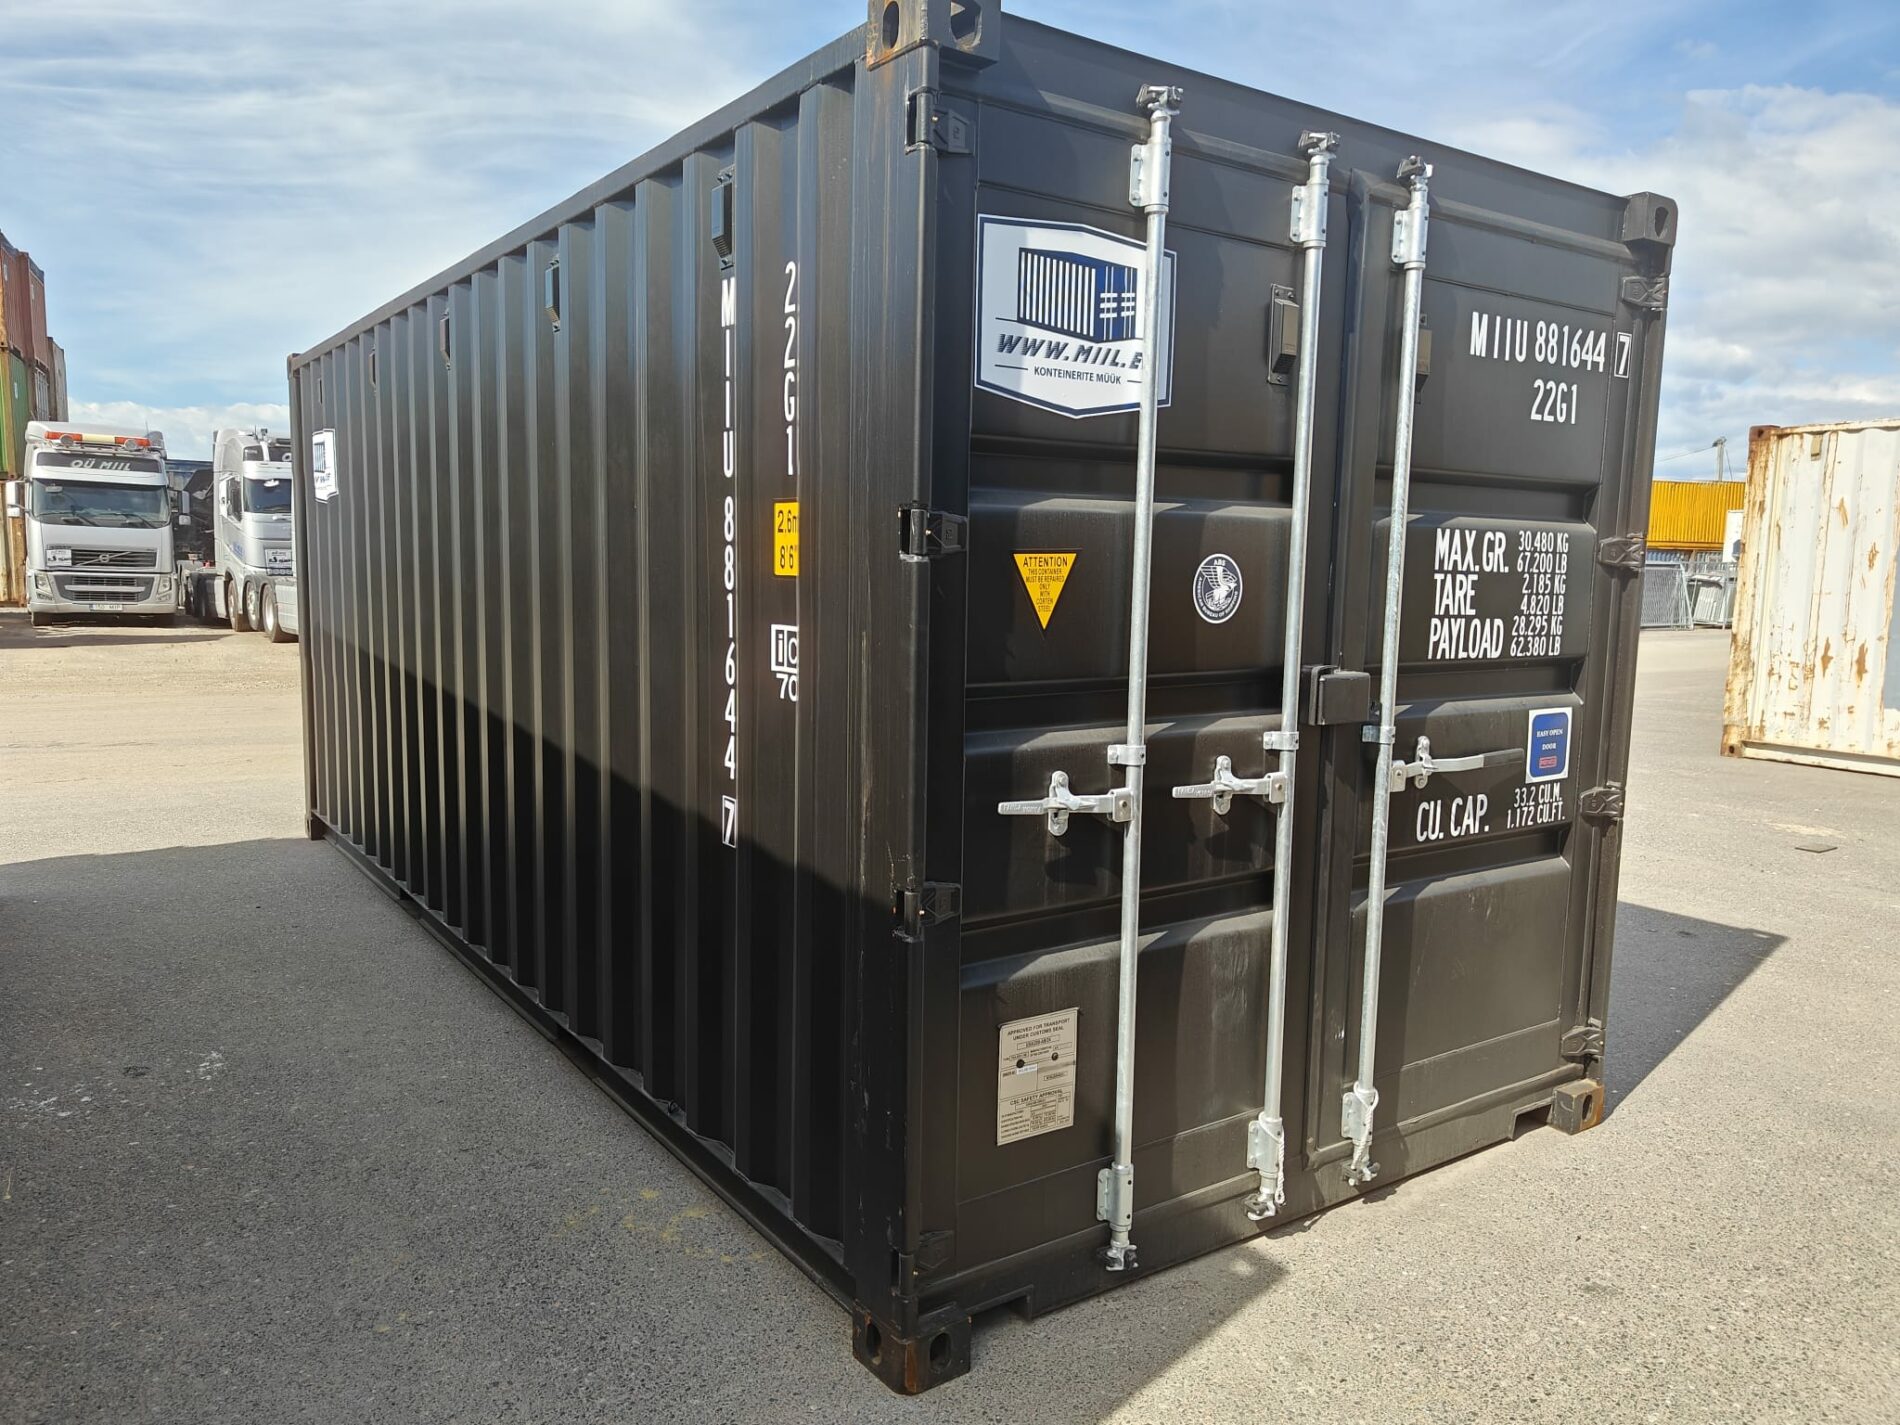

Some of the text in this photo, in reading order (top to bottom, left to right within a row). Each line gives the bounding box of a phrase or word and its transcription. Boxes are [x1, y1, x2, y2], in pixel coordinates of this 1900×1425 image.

[998, 333, 1144, 370] WWW.MIIL.E
[1469, 311, 1631, 376] MIIU 881644 7
[784, 260, 796, 476] 22G1
[1034, 366, 1121, 385] KONTEINERITE MÜÜK
[1530, 378, 1578, 425] 22G1
[71, 458, 131, 470] OÜ MIIL
[1518, 530, 1554, 552] 30.480
[1557, 532, 1569, 553] KG
[721, 276, 736, 846] MIIU 881644 7
[1023, 556, 1068, 567] ATTENTION
[1517, 552, 1567, 573] 67.200 LB
[1434, 573, 1566, 616] TARE 2.185 KG
[1520, 594, 1564, 615] 4.820 LB
[1428, 615, 1563, 660] PAYLOAD 28.295 KG
[1510, 636, 1561, 657] 62.380 LB
[776, 673, 799, 702] 70
[1536, 728, 1563, 738] EASY OPEN
[1542, 742, 1556, 750] DOOR
[1513, 785, 1536, 808] 33.2
[1416, 799, 1444, 842] CU.
[1450, 793, 1490, 837] CAP.
[1506, 806, 1535, 829] 1.172
[1008, 1026, 1032, 1036] APPROVED
[1043, 1017, 1070, 1027] TRANSPORT
